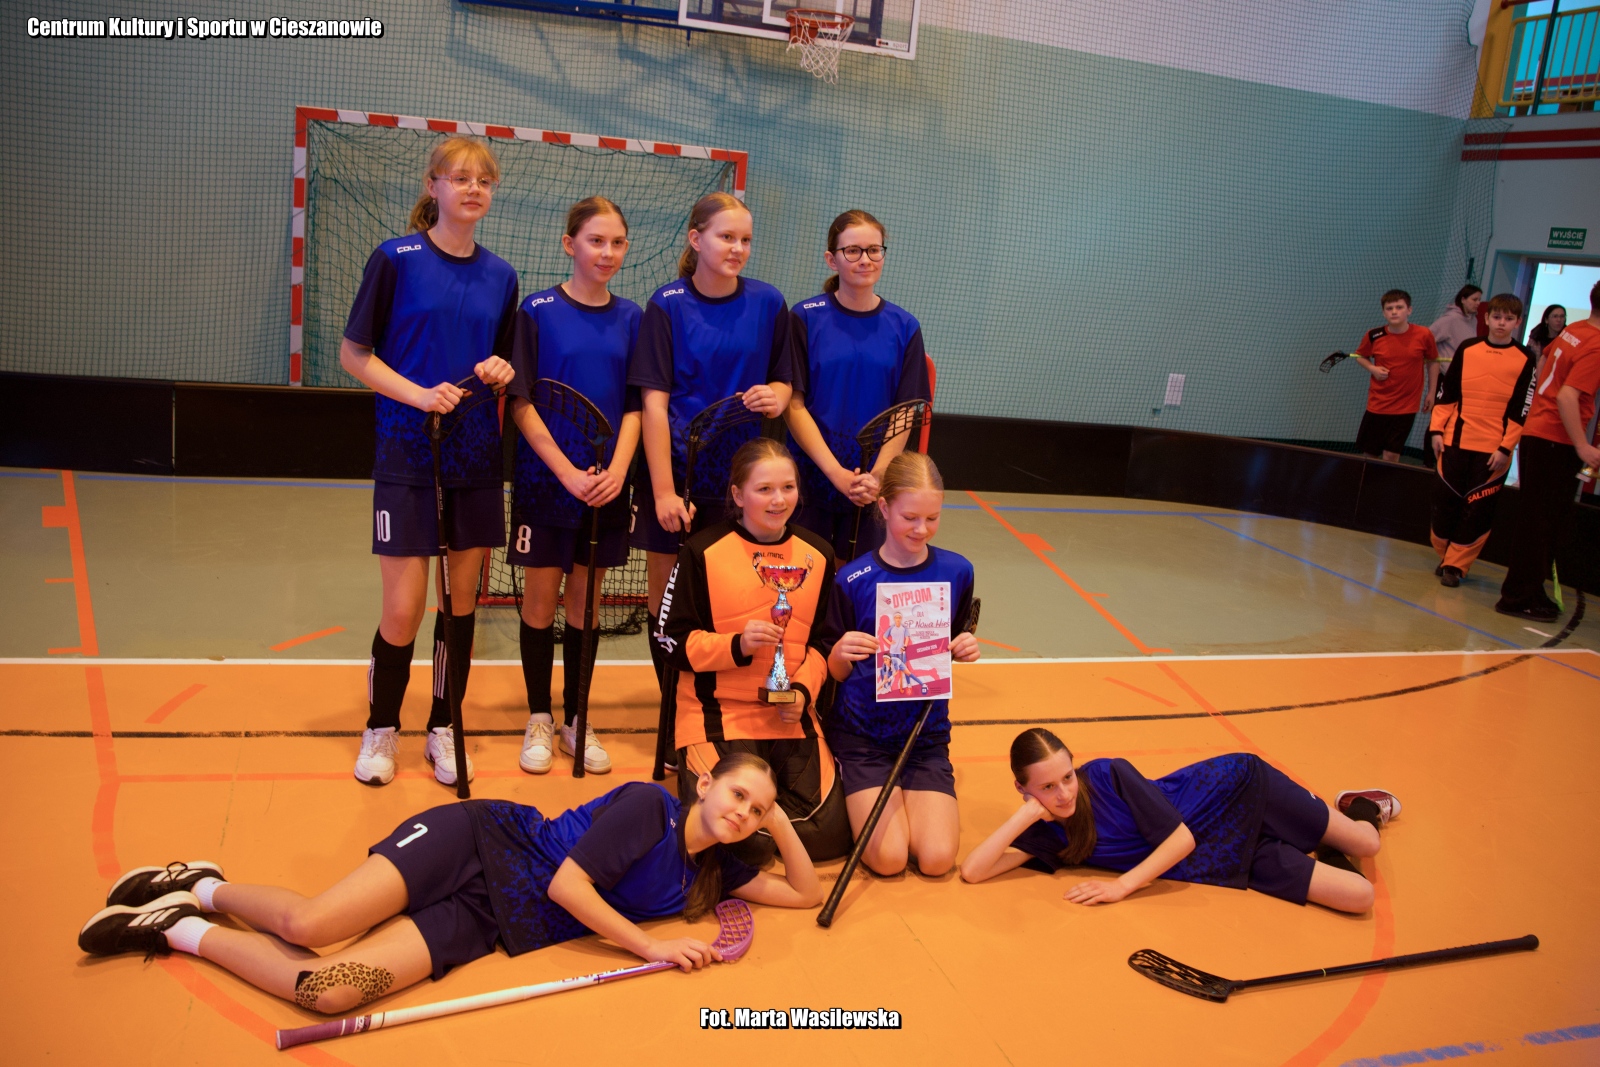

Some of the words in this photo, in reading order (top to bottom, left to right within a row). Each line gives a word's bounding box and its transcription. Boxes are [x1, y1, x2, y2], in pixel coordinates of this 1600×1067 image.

[1552, 230, 1585, 240] WYJŚCIE
[397, 244, 422, 254] COLO
[662, 288, 685, 298] COLO
[532, 296, 554, 307] COLO
[803, 301, 826, 309] COLO
[375, 510, 391, 542] 10
[515, 525, 532, 553] 8
[846, 565, 872, 583] COLO
[892, 587, 933, 609] DYPLOM
[396, 822, 428, 848] 7
